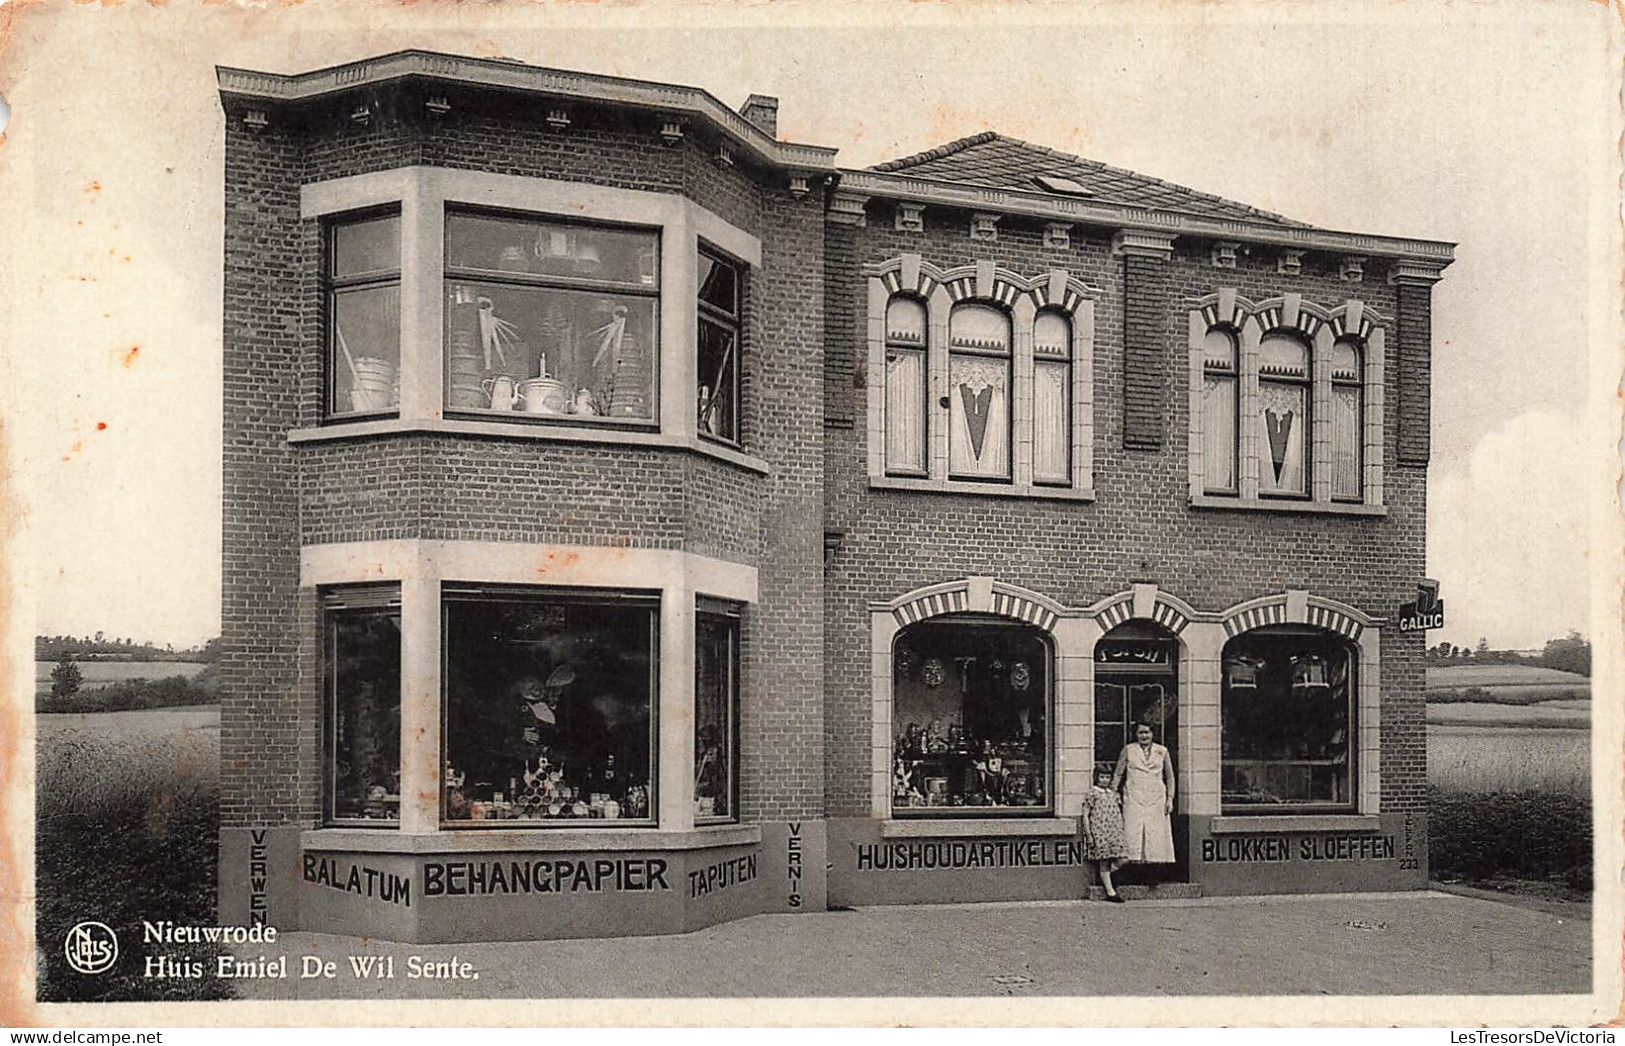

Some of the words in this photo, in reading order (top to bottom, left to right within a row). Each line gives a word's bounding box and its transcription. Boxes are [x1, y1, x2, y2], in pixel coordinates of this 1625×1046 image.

[1400, 614, 1442, 630] GALLIC
[788, 823, 801, 907] VERNIS
[857, 841, 1082, 870] HUISHOUDARTIKELEN
[1202, 838, 1290, 862] BLOKKEN
[1300, 836, 1395, 860] SLOEFFEN
[1400, 859, 1418, 870] 233
[250, 829, 267, 927] VERWEN
[303, 853, 410, 907] BALATUM
[424, 859, 669, 895] BEHANGPAPIER
